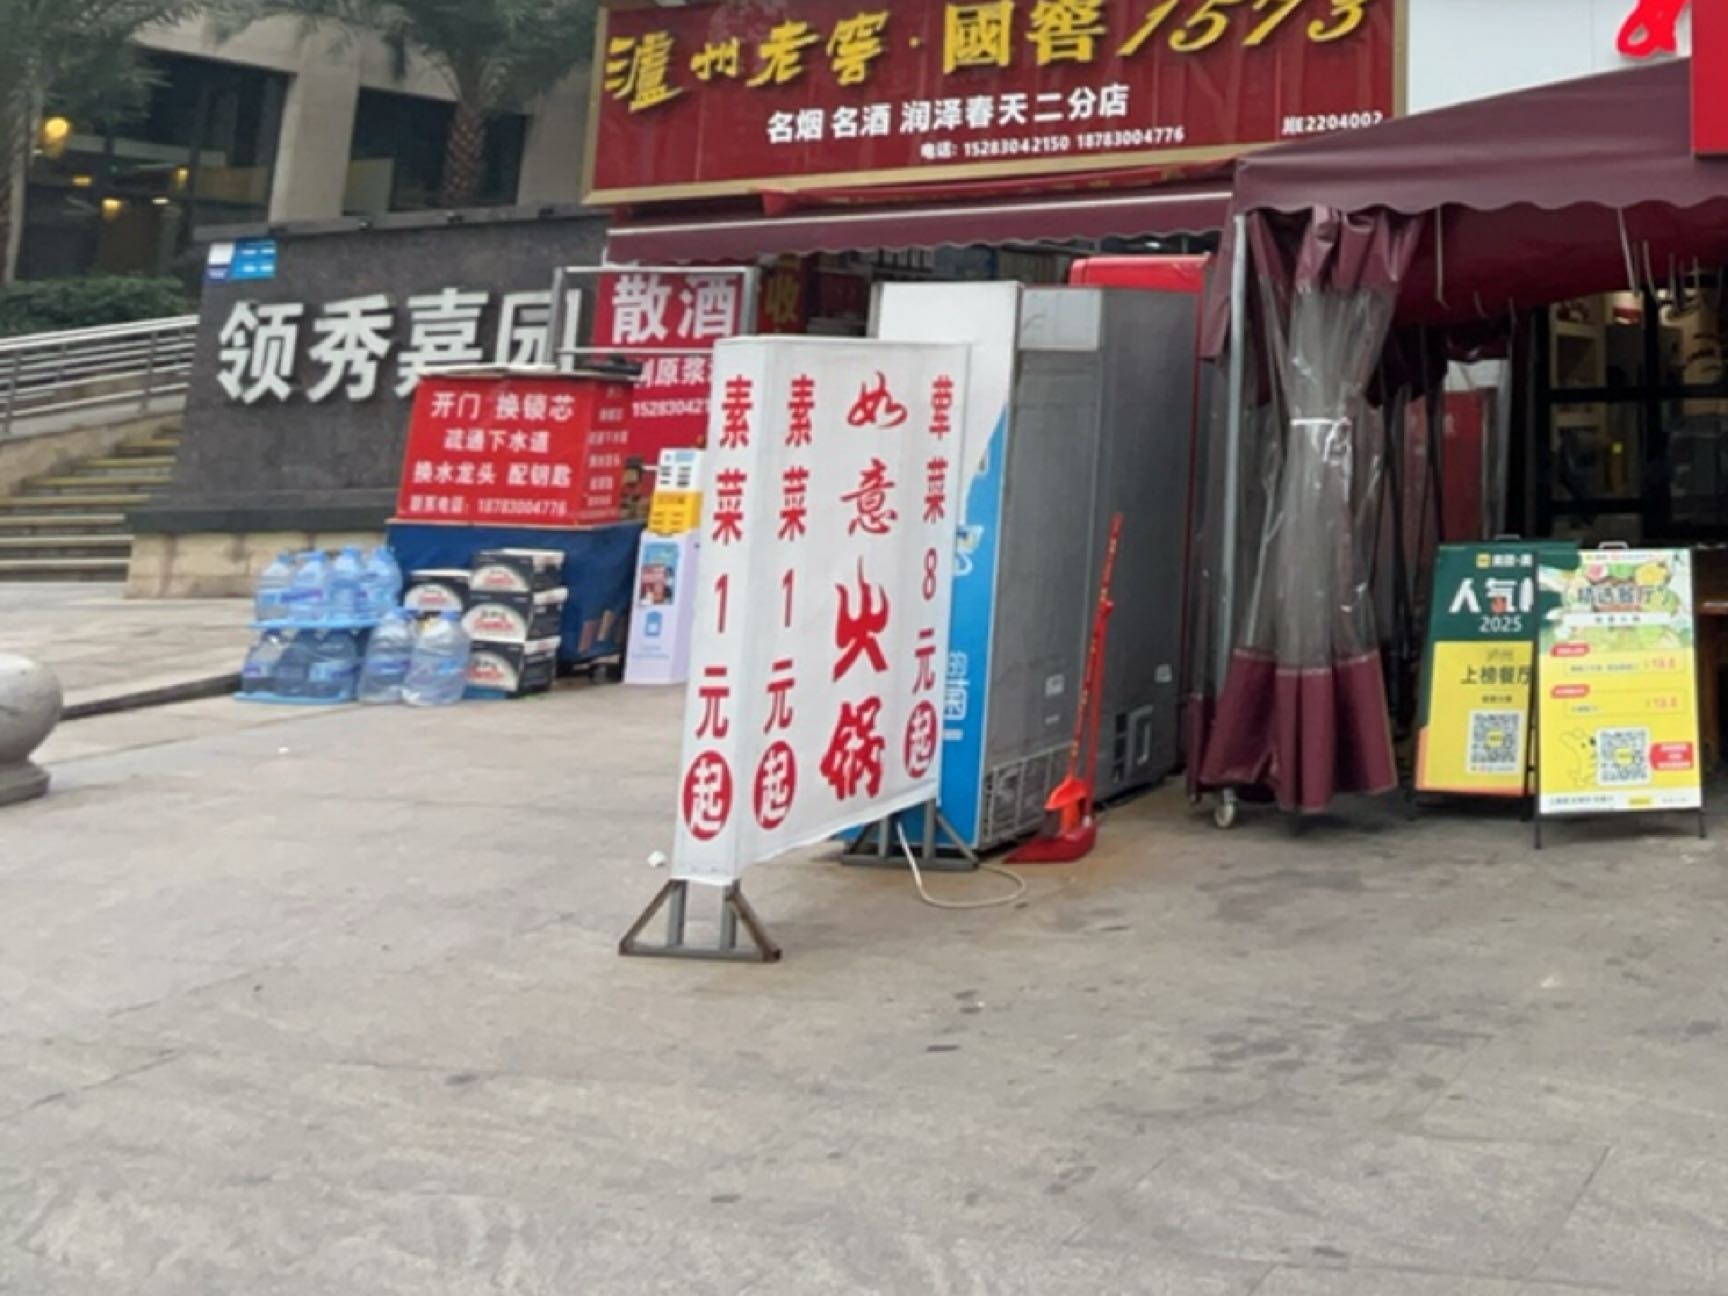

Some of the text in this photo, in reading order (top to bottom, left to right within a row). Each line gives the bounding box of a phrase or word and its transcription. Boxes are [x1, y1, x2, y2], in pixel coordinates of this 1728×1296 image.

[766, 83, 1130, 144] 名烟 名酒 润泽春天二分店
[611, 274, 737, 345] 散酒
[430, 391, 481, 418] 开门
[819, 369, 908, 803] 如意火锅
[1479, 615, 1522, 633] 2025
